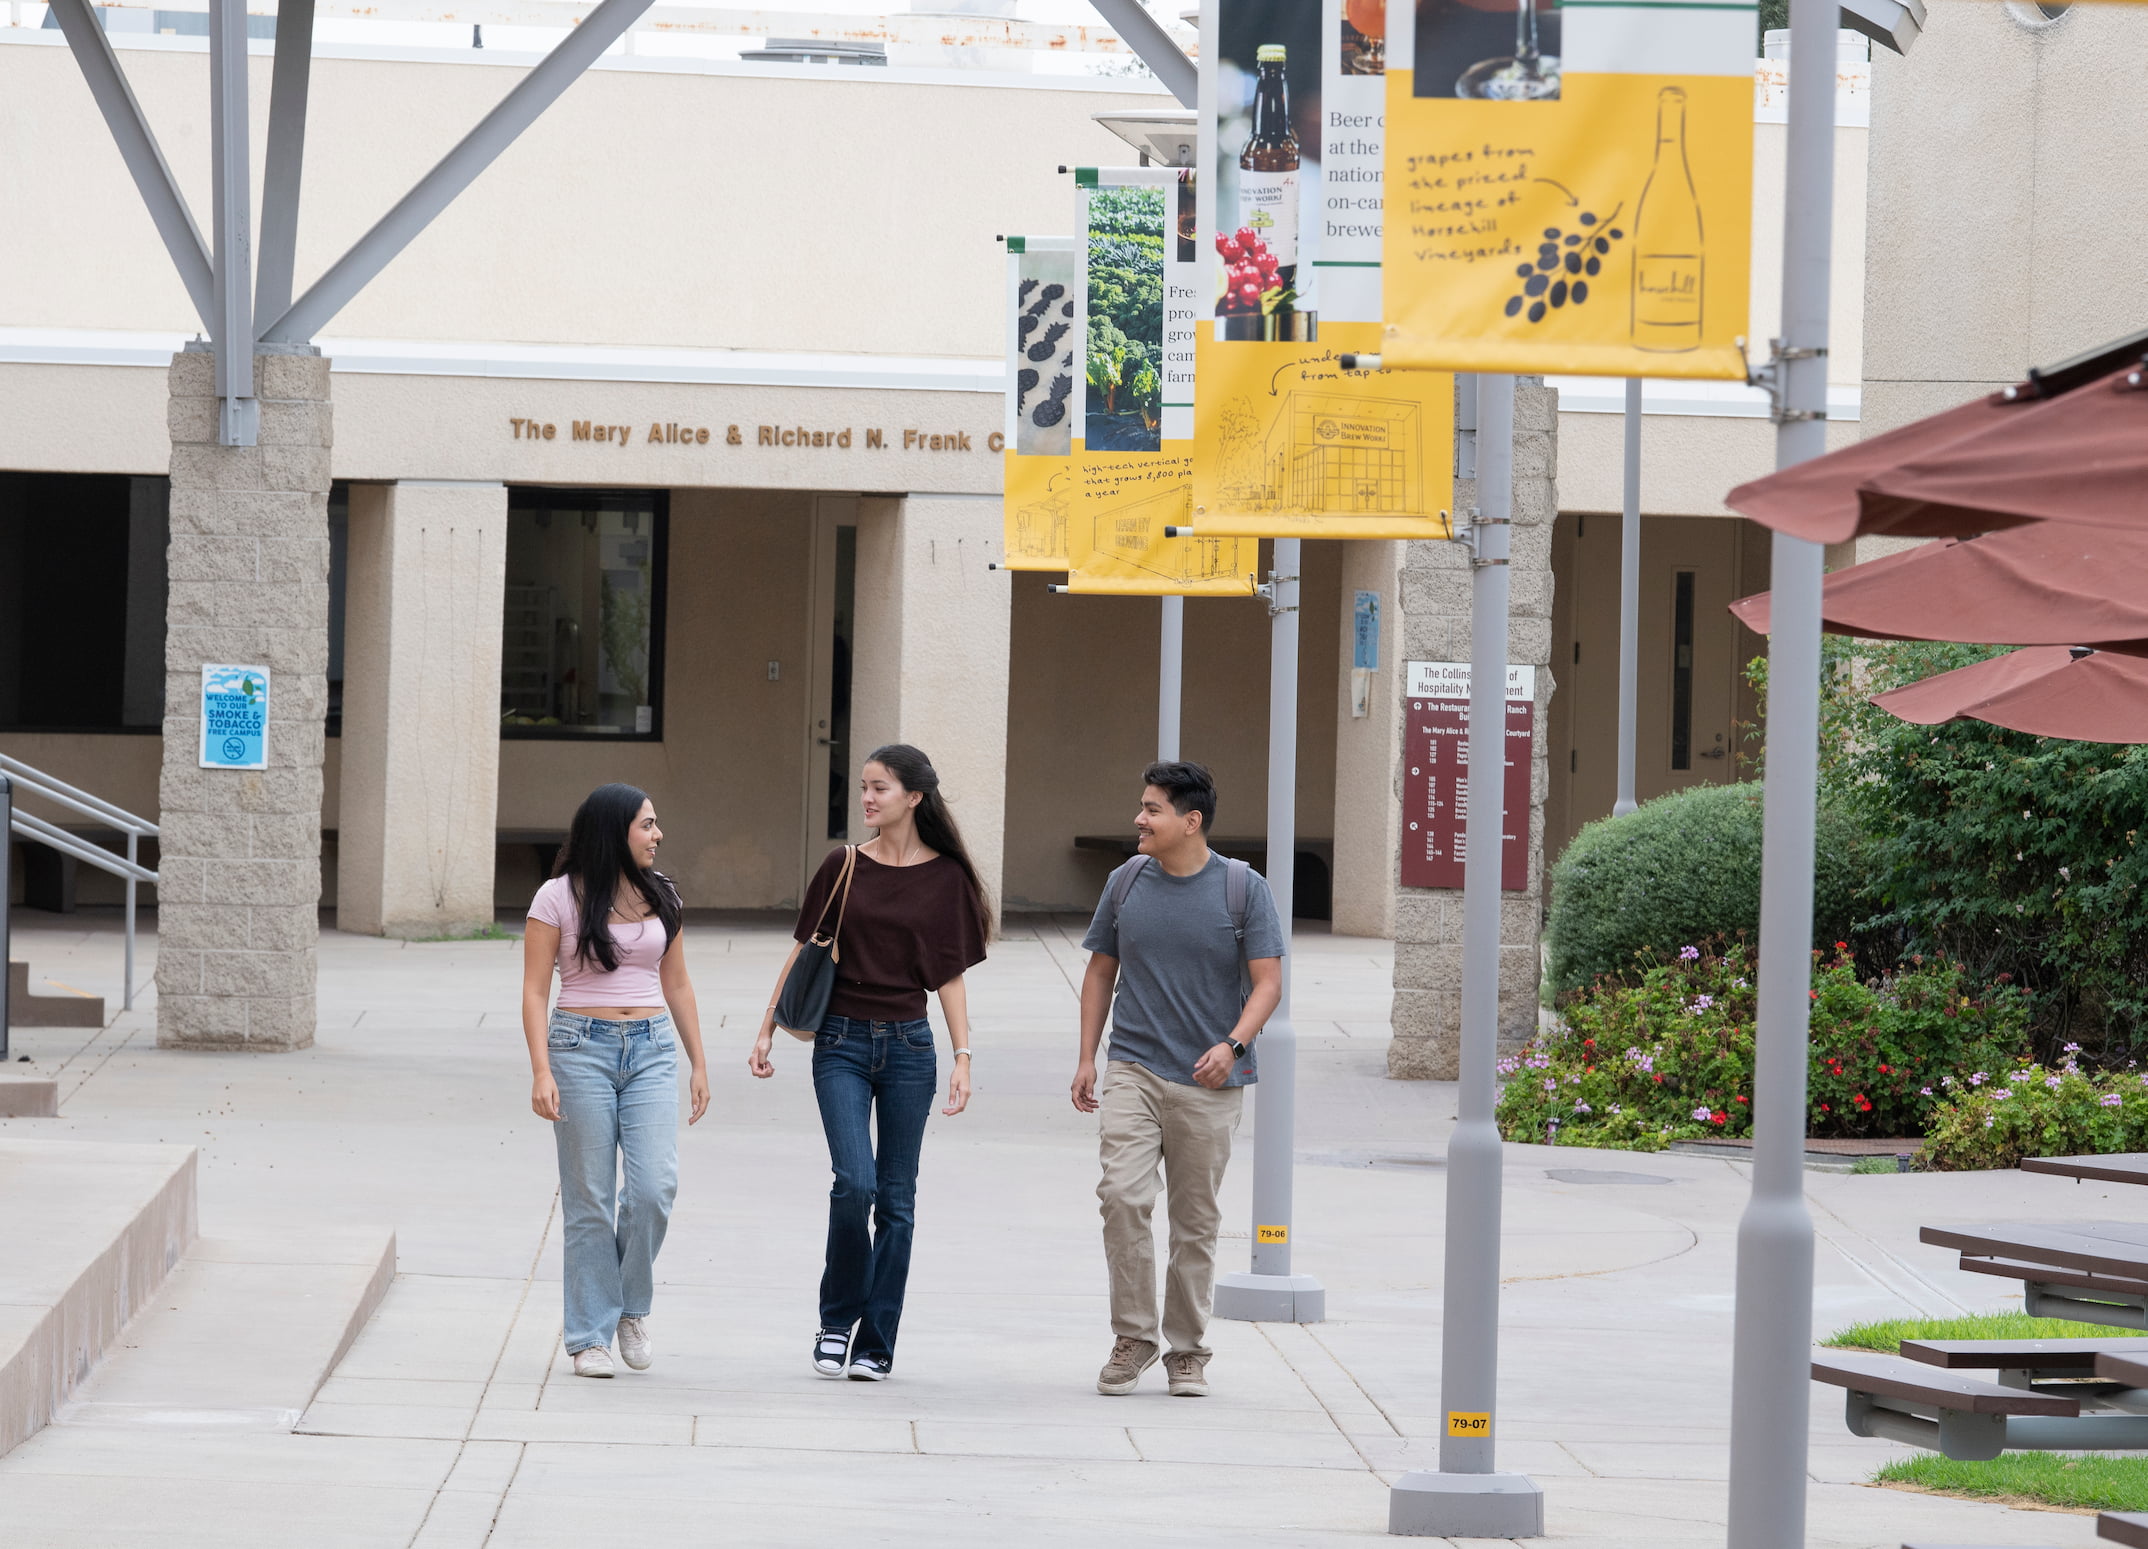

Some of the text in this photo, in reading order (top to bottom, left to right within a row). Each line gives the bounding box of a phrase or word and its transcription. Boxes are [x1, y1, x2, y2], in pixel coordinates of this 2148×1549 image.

[1330, 111, 1373, 128] Beer
[1329, 139, 1380, 155] at the
[1407, 144, 1535, 172] grapes from
[1408, 177, 1448, 189] the
[1410, 190, 1521, 216] lineage of
[1169, 309, 1196, 322] pro
[1301, 370, 1338, 381] from
[1341, 422, 1386, 433] INNOVATION
[511, 418, 557, 440] The
[572, 420, 632, 446] Mary
[648, 422, 710, 444] Alice
[727, 424, 743, 445] &
[759, 425, 852, 448] Richard
[866, 428, 889, 449] N.
[903, 429, 972, 451] Frank
[1082, 462, 1134, 476] high-tech
[1138, 457, 1180, 468] vertical
[1084, 469, 1193, 486] that grows 8,800 pla
[1095, 489, 1120, 499] year
[1424, 667, 1519, 681] The Collins of
[1418, 682, 1464, 696] Hospitality
[206, 694, 247, 702] WELCOME
[229, 702, 247, 710] OUR
[1427, 702, 1439, 711] The
[1507, 704, 1527, 715] Ranch
[208, 709, 261, 720] SMOKE &
[209, 719, 261, 729] TOBACCO
[208, 728, 261, 737] FREE CAMPUS
[1432, 727, 1445, 736] Mary
[1446, 727, 1459, 735] Alice
[1260, 1230, 1286, 1238] 79-06
[1452, 1418, 1487, 1429] 79-07
